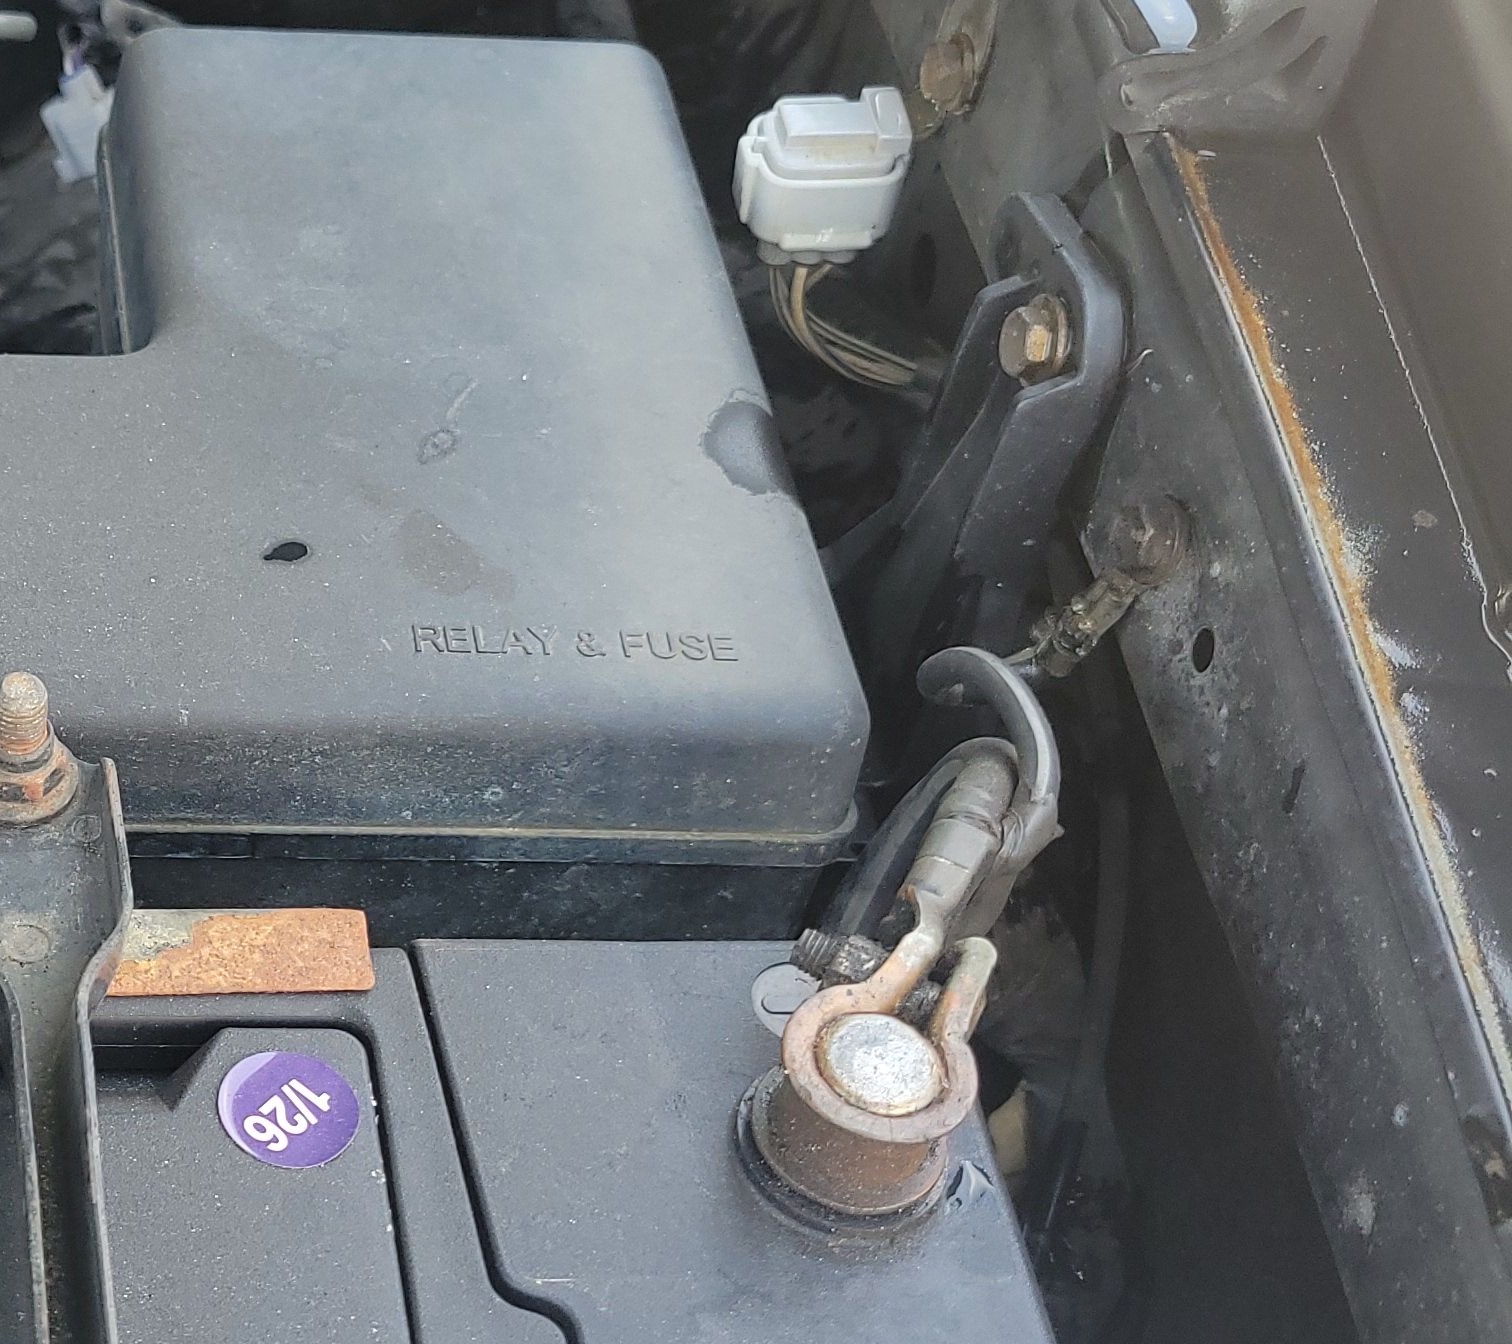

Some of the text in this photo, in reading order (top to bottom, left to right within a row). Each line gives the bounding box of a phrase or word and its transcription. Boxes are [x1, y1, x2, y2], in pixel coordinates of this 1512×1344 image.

[411, 624, 739, 661] RELAY & FUSE
[243, 1078, 330, 1152] 1/26
